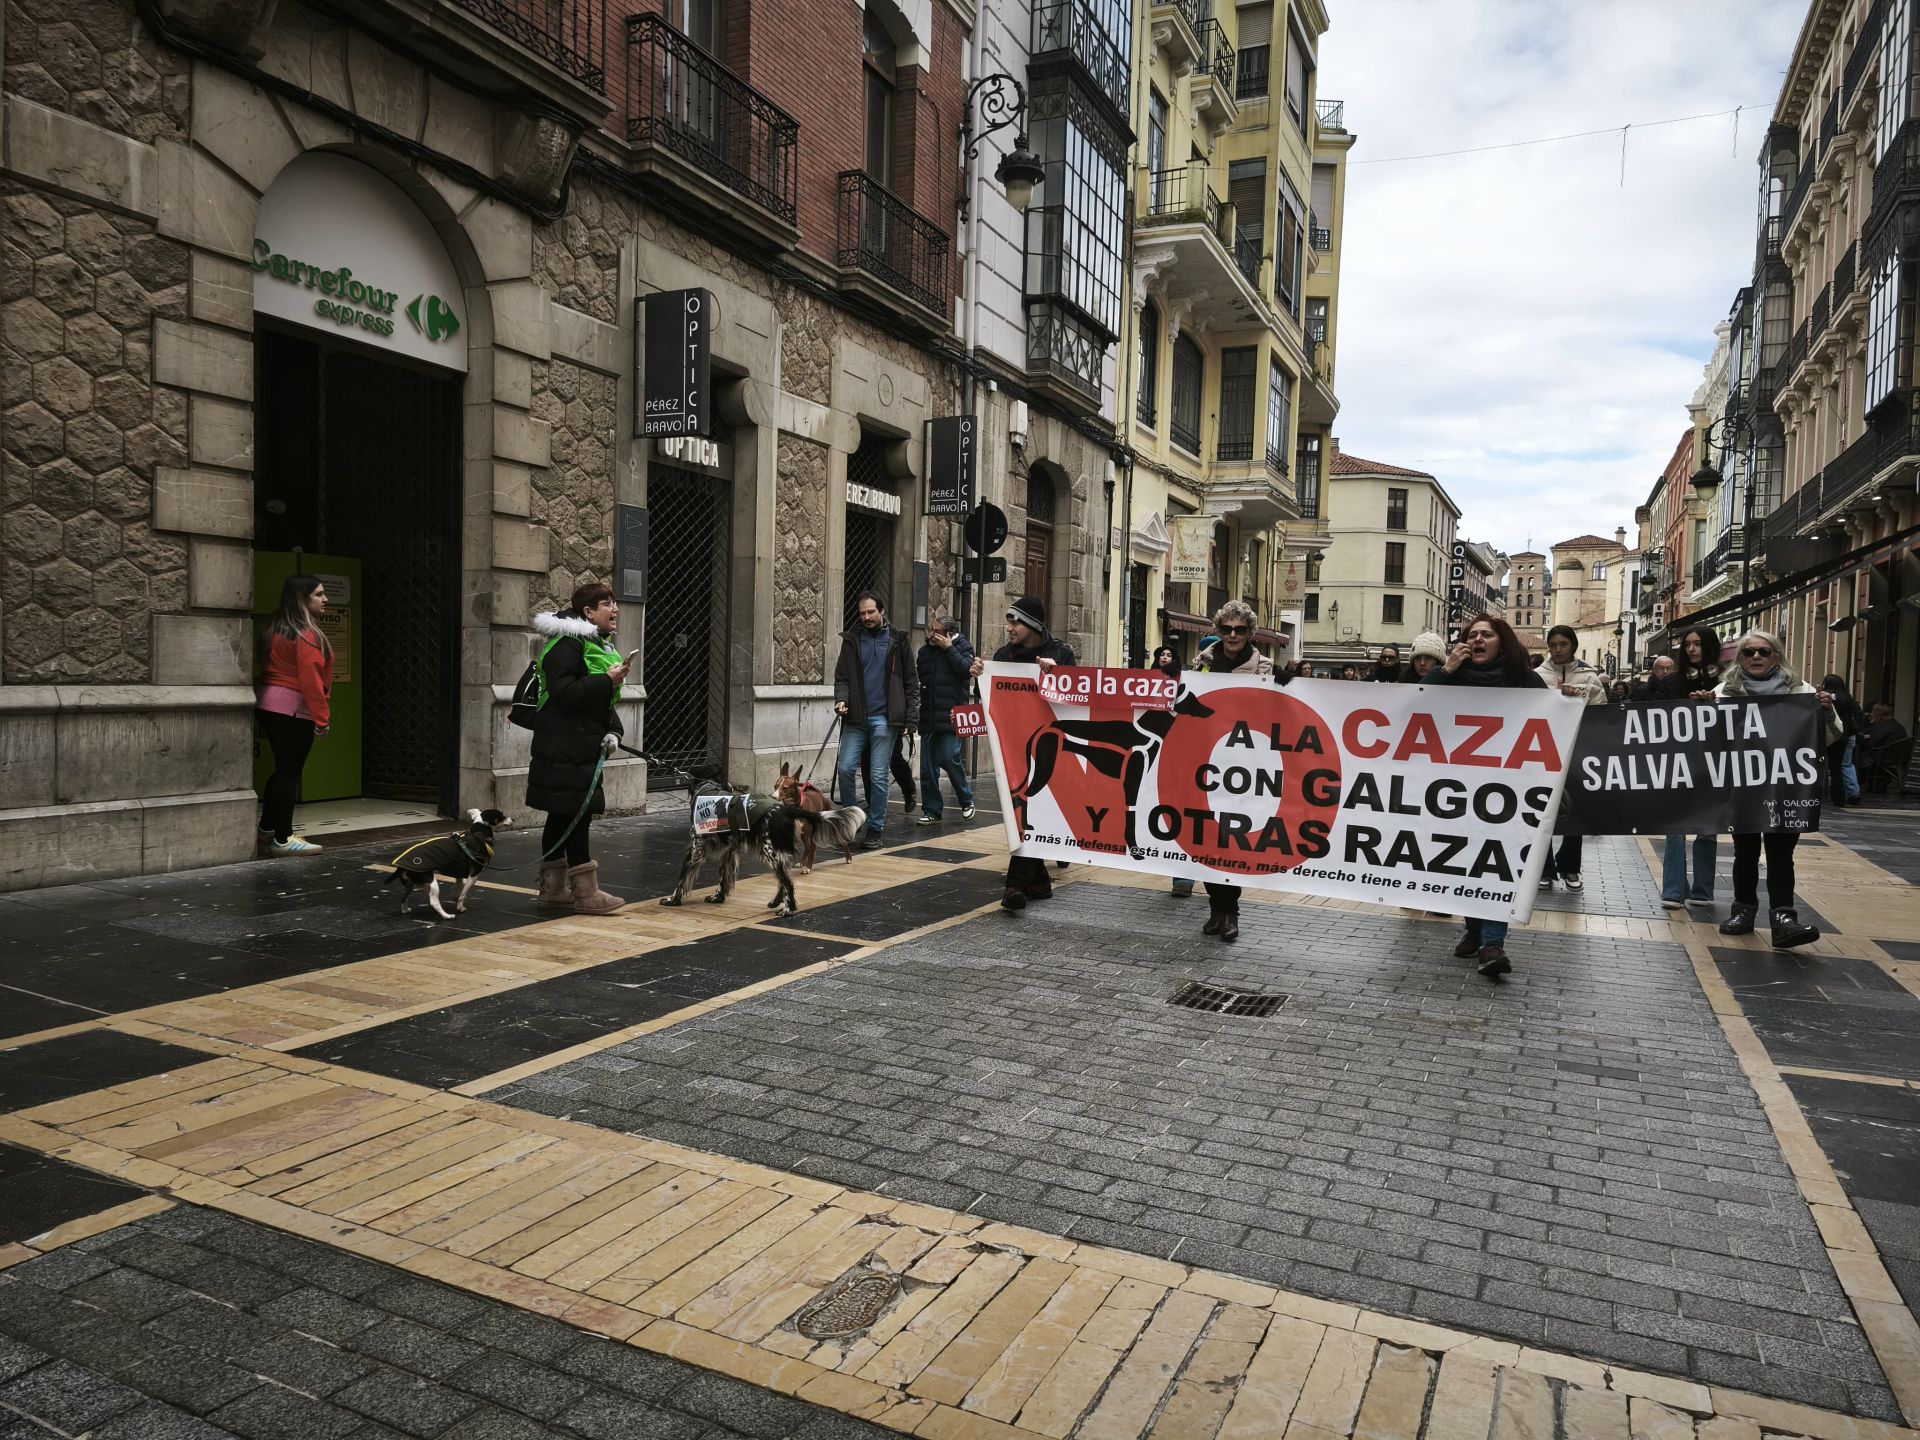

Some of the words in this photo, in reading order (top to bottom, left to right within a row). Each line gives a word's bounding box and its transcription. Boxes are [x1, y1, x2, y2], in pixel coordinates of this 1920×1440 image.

[252, 238, 399, 313] Carrefour
[315, 298, 395, 336] express
[646, 420, 682, 433] BRAVO
[872, 489, 901, 516] BRAVO
[930, 503, 957, 513] BRAVO
[316, 614, 341, 623] VISO
[1040, 689, 1057, 699] con
[1058, 692, 1089, 703] perros
[1042, 673, 1072, 693] no
[1077, 674, 1091, 694] a
[1096, 669, 1116, 695] la
[1123, 677, 1177, 699] caza
[956, 711, 980, 727] no
[1623, 703, 1767, 745] ADOPTA
[1225, 720, 1255, 750] A
[1269, 722, 1324, 755] LA
[1341, 708, 1563, 773] CAZA
[1582, 753, 1694, 791] SALVA
[1704, 747, 1818, 788] VIDAS
[1195, 763, 1284, 799] CON
[1301, 768, 1554, 829] GALGOS
[1783, 799, 1820, 807] GALGOS
[699, 807, 711, 820] NO
[1784, 809, 1797, 818] DE
[1784, 819, 1809, 828] LEÓN
[1085, 805, 1110, 834] Y
[1148, 804, 1331, 859] OTRAS
[1035, 834, 1061, 845] más
[1065, 835, 1127, 856] indefensa
[1129, 846, 1158, 858] está
[1163, 850, 1188, 862] una
[1192, 853, 1251, 872] criatura,
[1256, 861, 1287, 874] más
[1293, 865, 1356, 883] derecho
[1361, 873, 1402, 888] tiene
[1406, 880, 1416, 890] a
[1421, 883, 1449, 894] ser
[1453, 885, 1517, 903] defend
